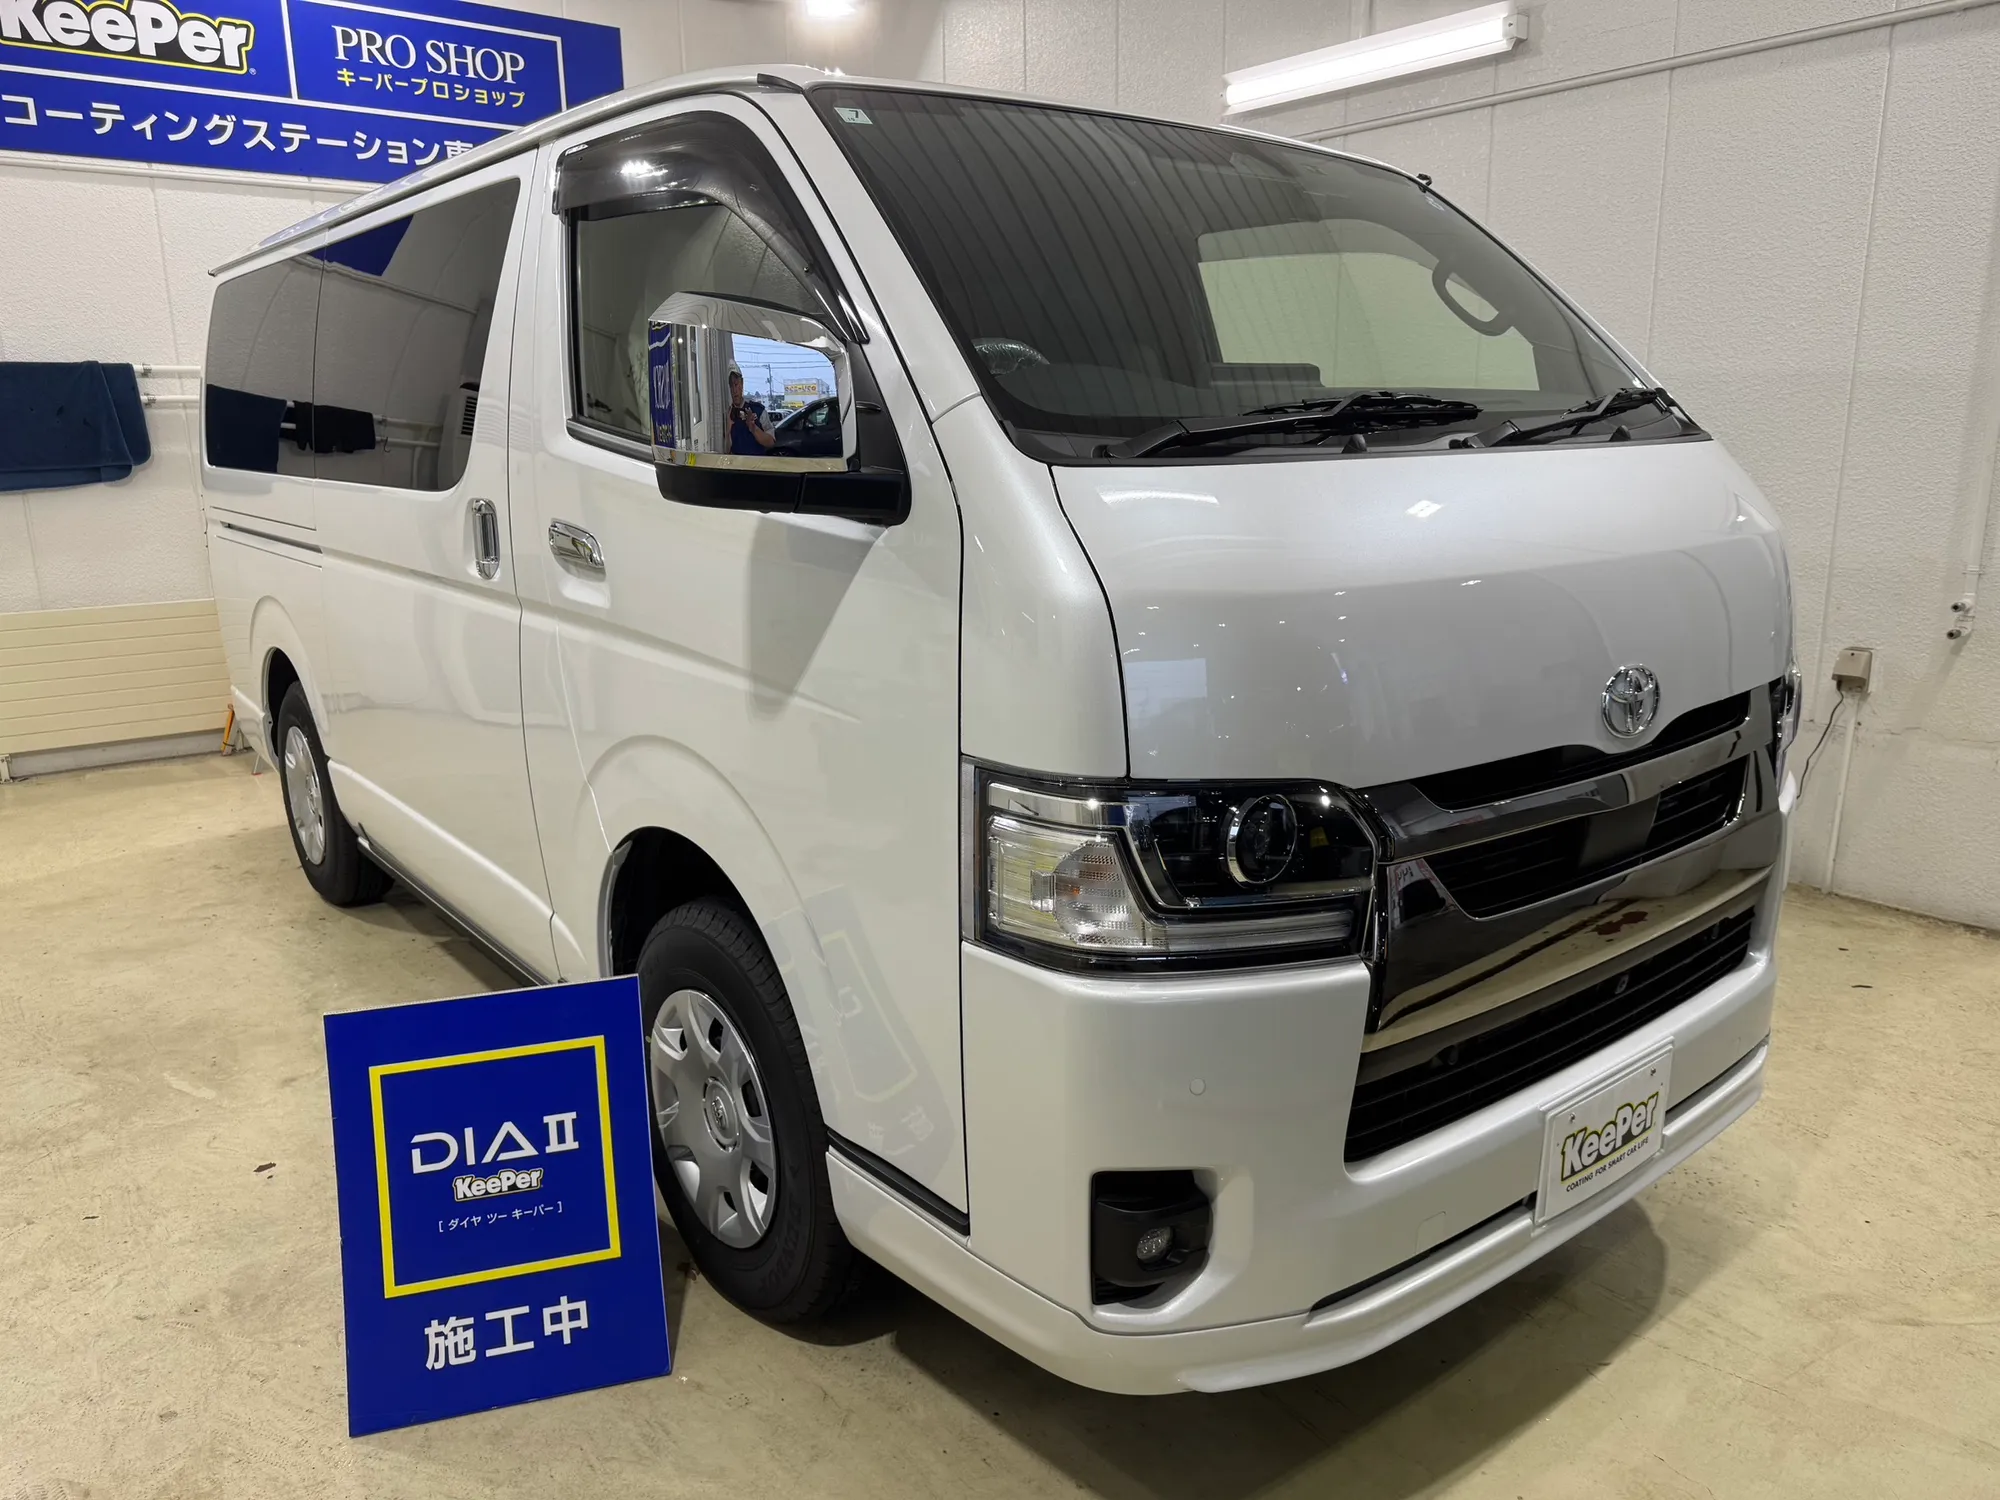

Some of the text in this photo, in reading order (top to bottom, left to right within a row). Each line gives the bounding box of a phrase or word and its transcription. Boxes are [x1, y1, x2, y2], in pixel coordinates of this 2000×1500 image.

[0, 0, 251, 70] KeePer
[331, 25, 526, 84] PRO SHOP
[337, 68, 526, 108] キーパープロショップ
[410, 1121, 539, 1174] DIA
[1561, 1092, 1659, 1181] KeePer
[1566, 1136, 1649, 1192] COATING FOR SMART CAR LIFE
[453, 1168, 543, 1201] KeePer
[424, 1295, 589, 1371] 施工中
